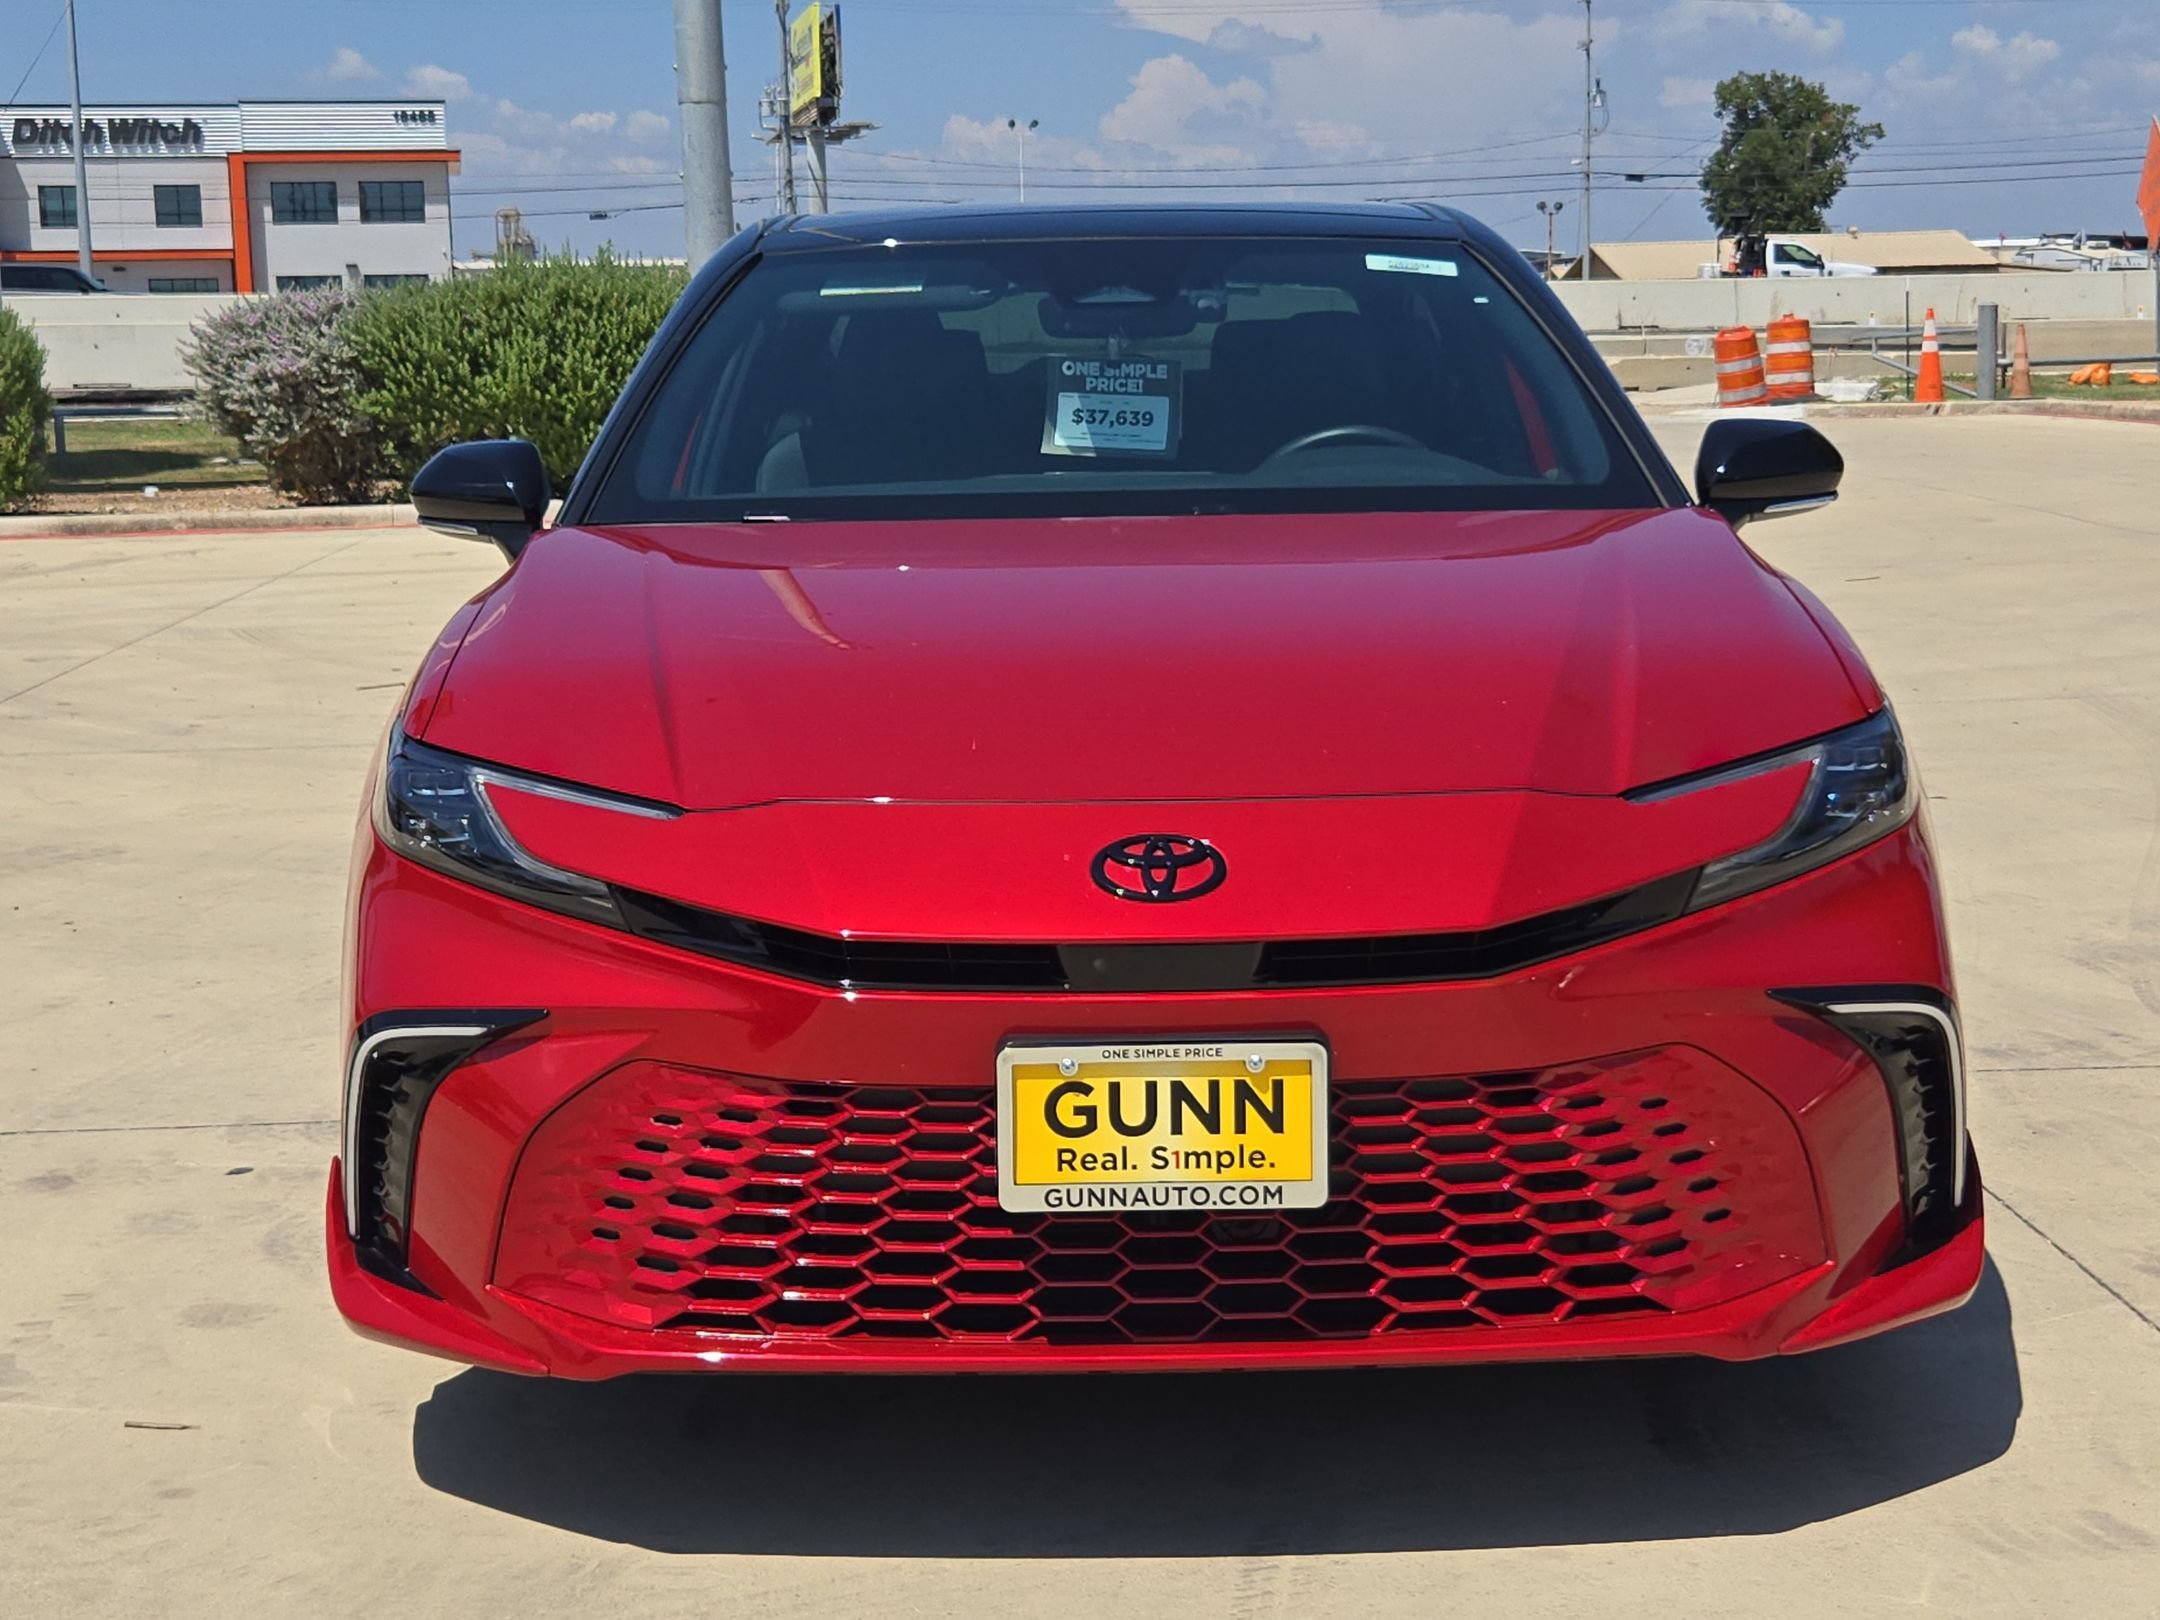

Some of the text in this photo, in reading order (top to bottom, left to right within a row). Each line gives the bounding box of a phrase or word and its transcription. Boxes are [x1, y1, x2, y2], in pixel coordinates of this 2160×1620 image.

[107, 118, 203, 145] Witch
[1061, 360, 1100, 376] ONE
[1071, 408, 1154, 428] $37,639
[1101, 1047, 1223, 1059] ONE SIMPLE PRICE
[1043, 1078, 1285, 1139] GUNN
[1056, 1146, 1138, 1172] Real.
[1043, 1185, 1284, 1208] GUNNAUTO.COM
